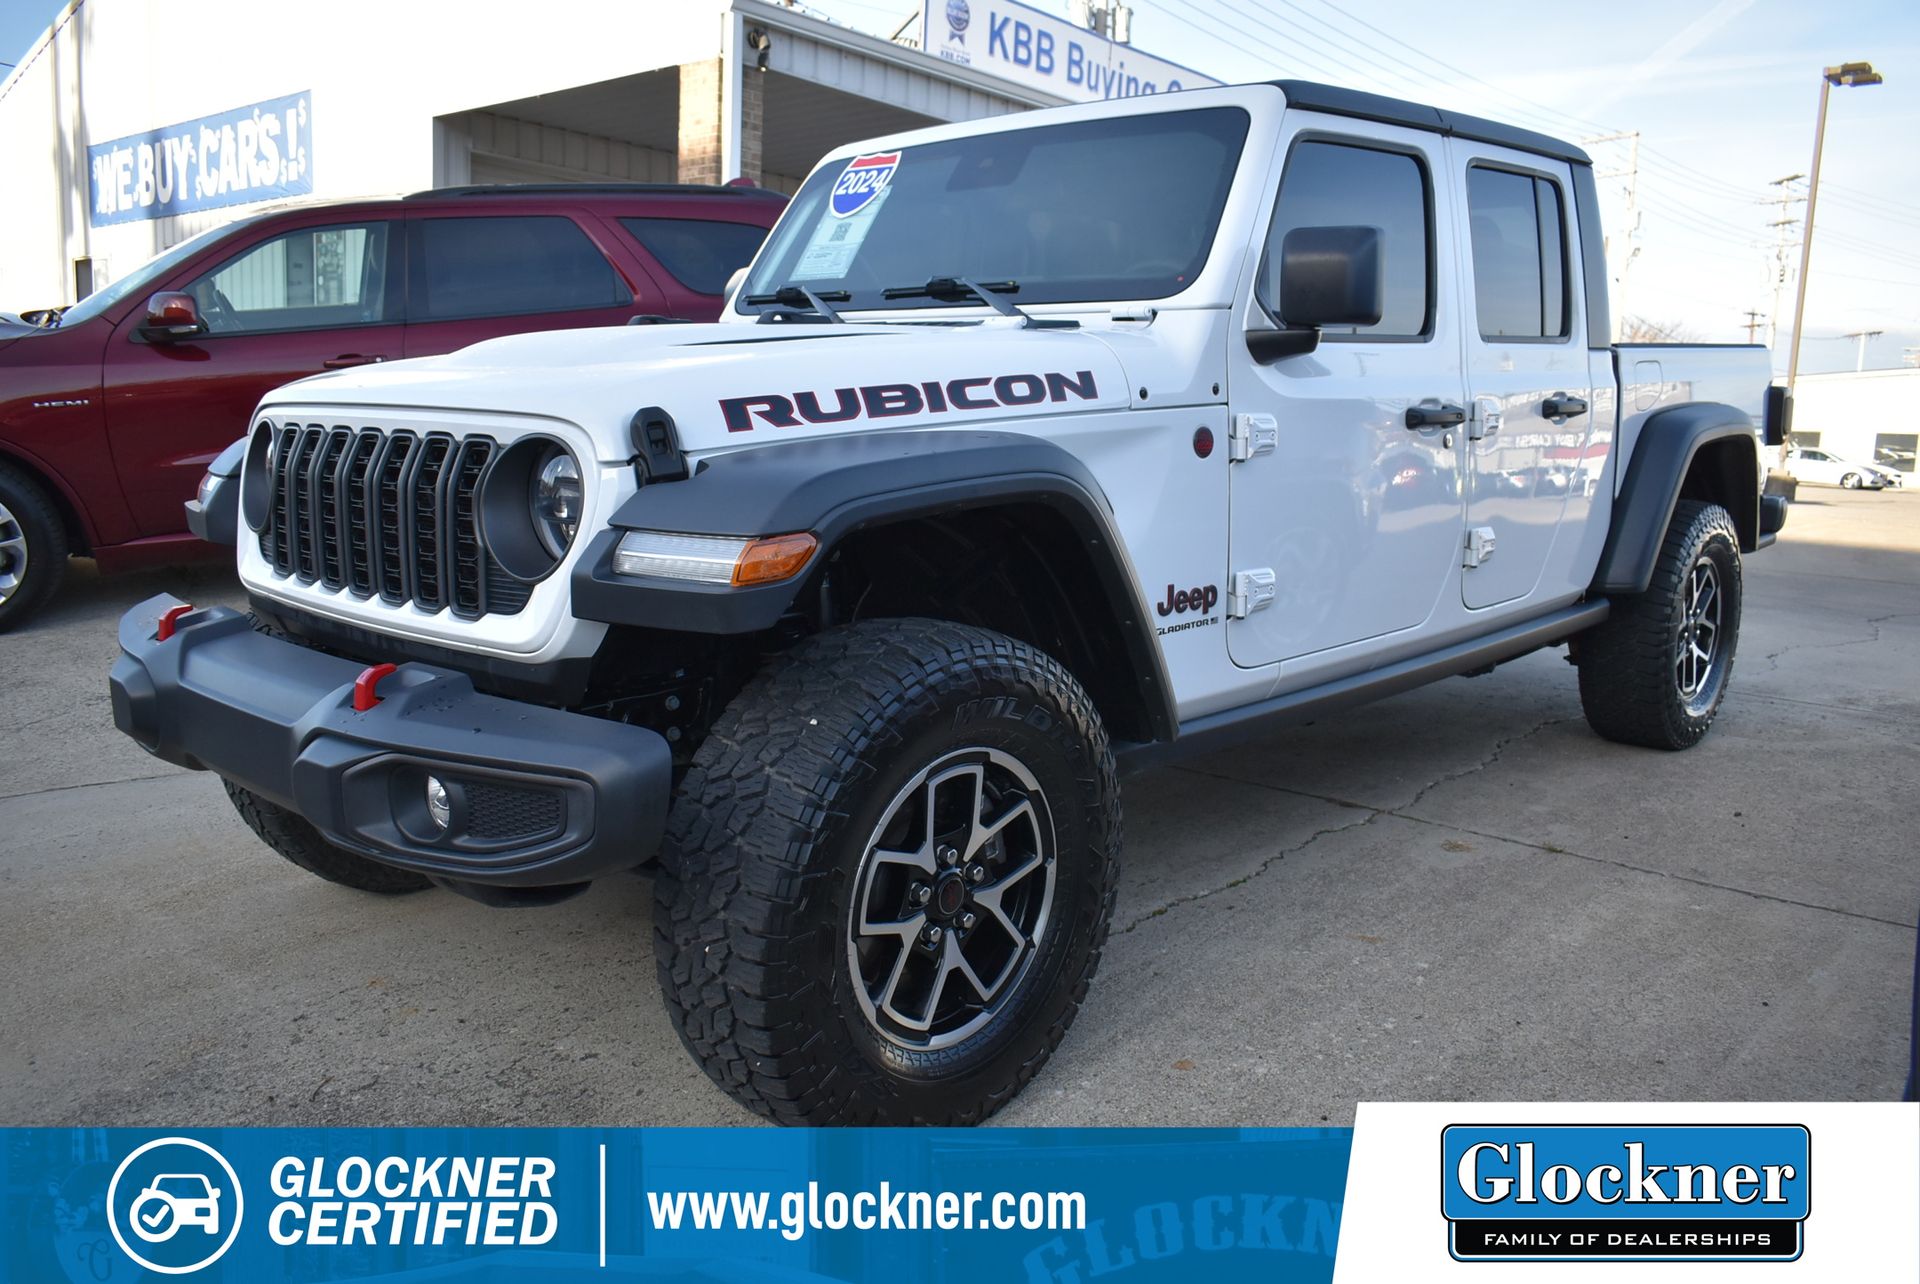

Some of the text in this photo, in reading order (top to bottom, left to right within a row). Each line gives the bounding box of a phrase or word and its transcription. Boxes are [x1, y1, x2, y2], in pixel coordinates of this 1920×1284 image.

[988, 11, 1056, 76] KBB
[93, 145, 133, 215] WE
[134, 133, 194, 207] BUY
[835, 168, 890, 196] 2024
[33, 398, 90, 408] HEMI
[718, 369, 1099, 433] RUBICON
[1156, 583, 1218, 617] Jeep
[1156, 618, 1210, 636] GLADIATOR
